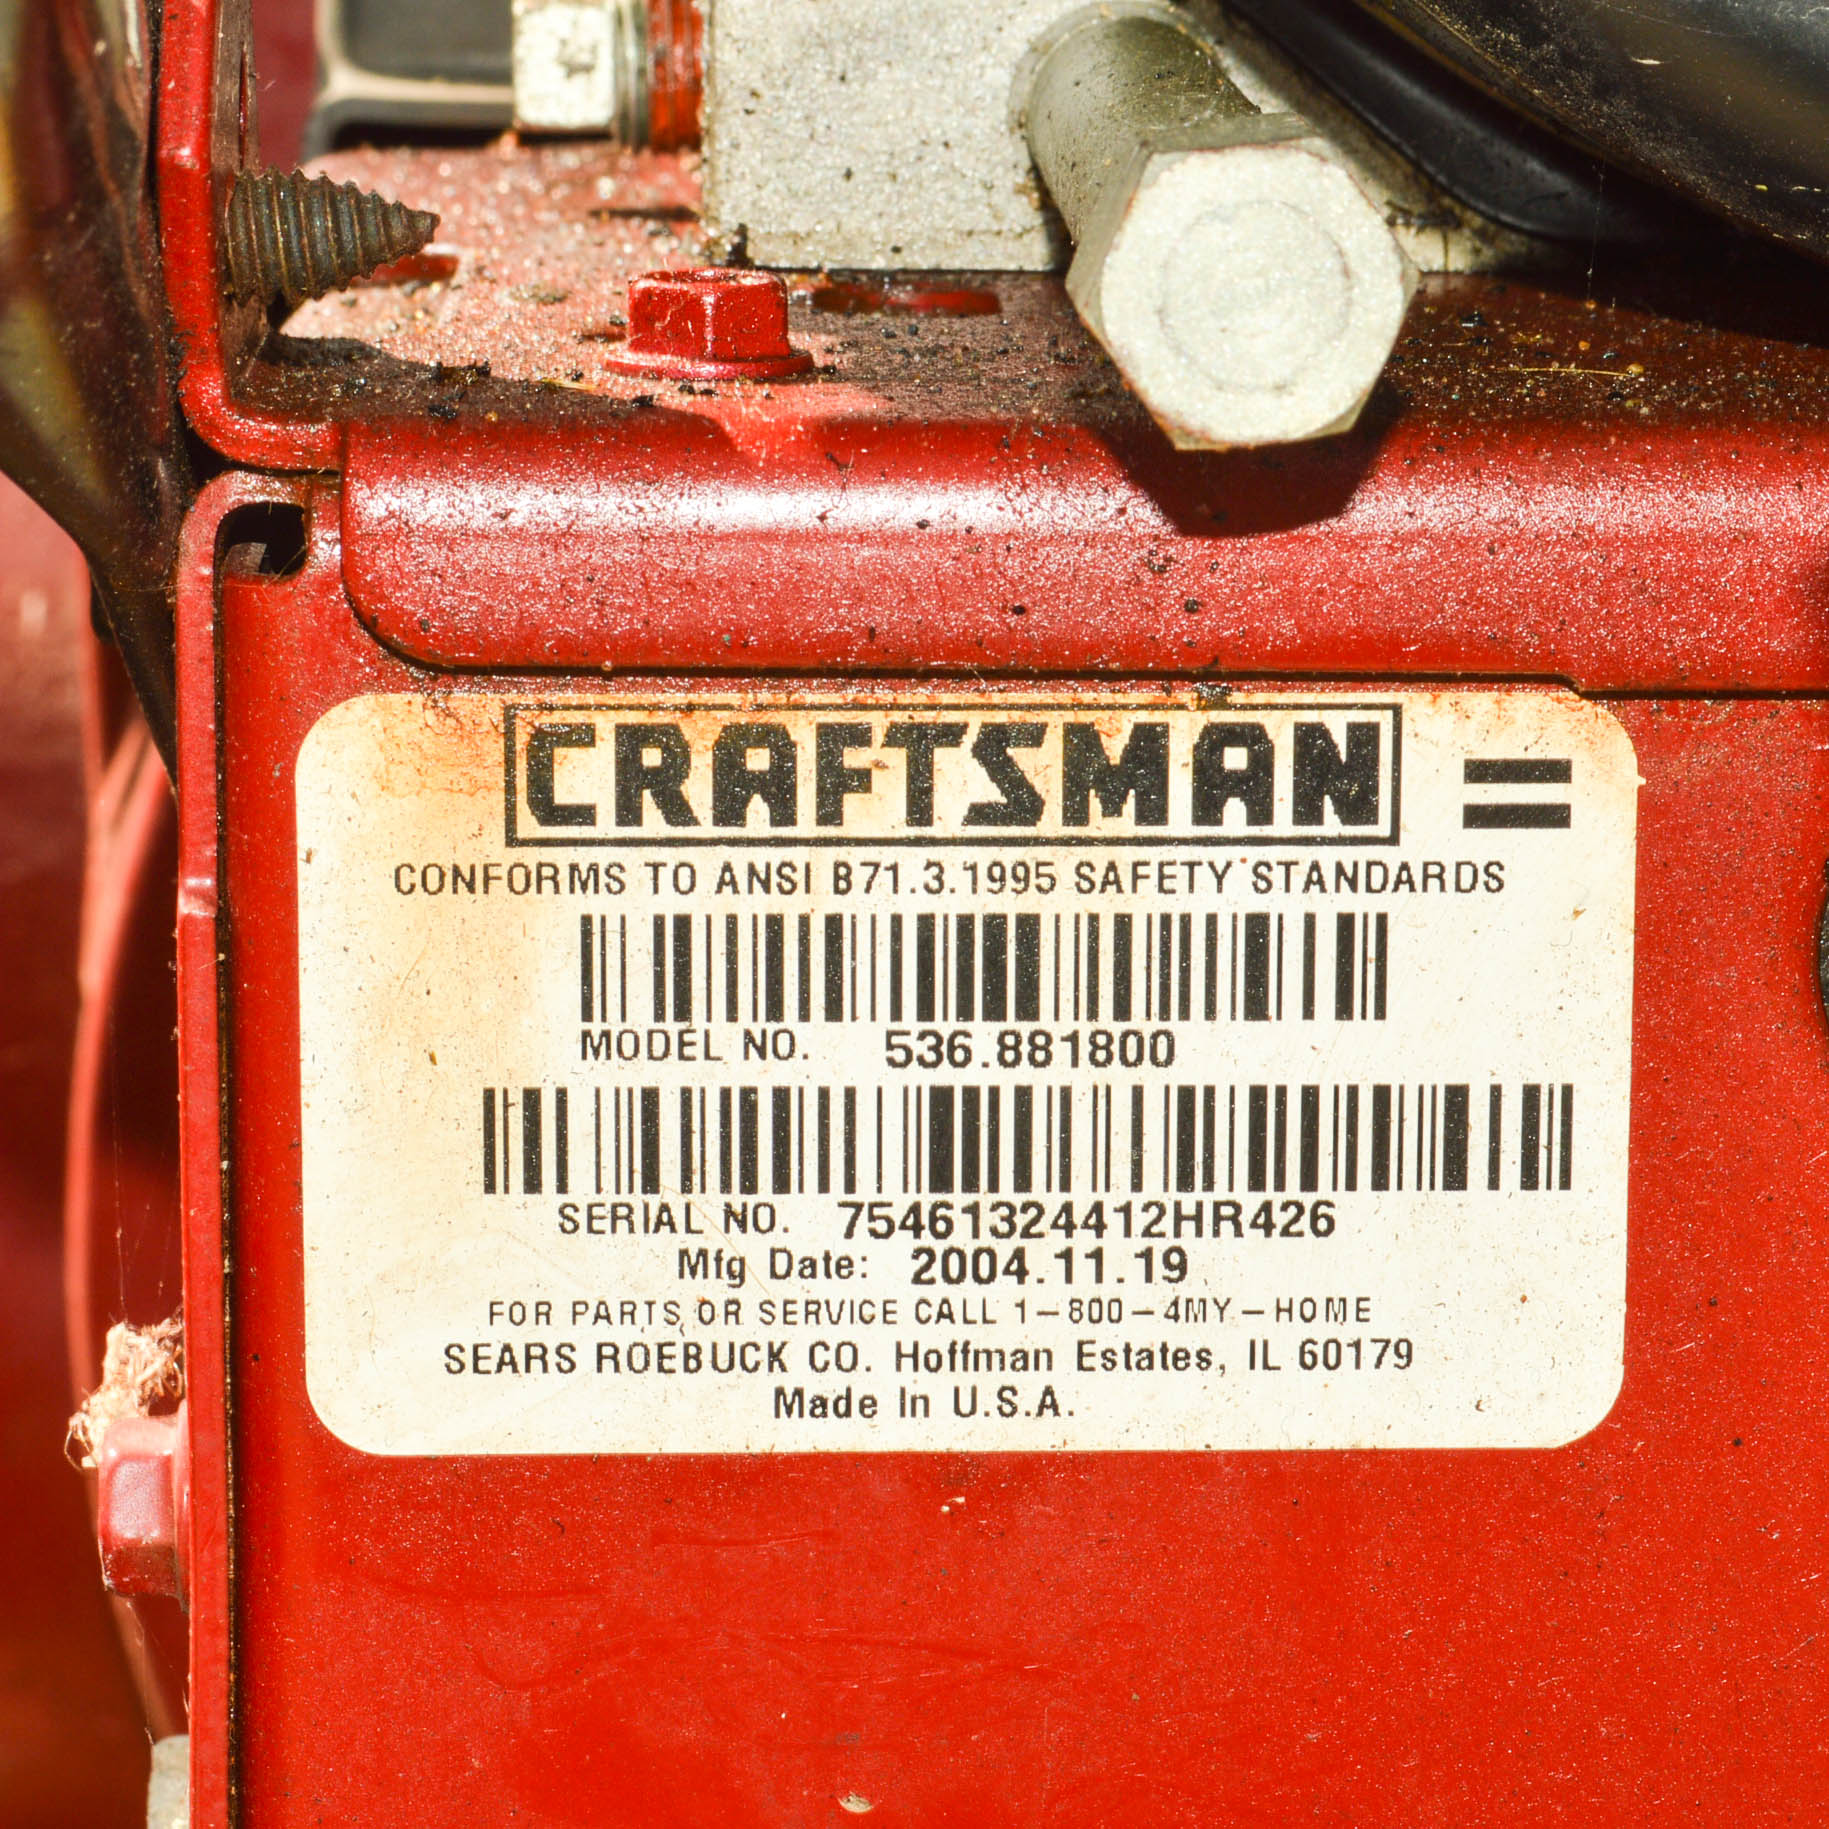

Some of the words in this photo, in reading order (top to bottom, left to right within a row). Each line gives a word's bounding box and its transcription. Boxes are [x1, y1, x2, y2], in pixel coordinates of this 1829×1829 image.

[525, 721, 1380, 828] CRAFTSMAN
[393, 861, 627, 896] CONFORMS
[643, 861, 697, 895] TO
[714, 861, 812, 895] ANSI
[832, 860, 1058, 895] B71.3.1995
[1074, 860, 1233, 895] SAFETY
[1251, 860, 1506, 894] STANDARDS
[581, 1028, 723, 1062] MODEL
[743, 1028, 810, 1061] NO.
[884, 1029, 1176, 1069] 536.881800
[558, 1201, 705, 1235] SERIAL
[722, 1201, 790, 1235] NO.
[836, 1200, 1337, 1240] 75461324412HR426
[677, 1247, 746, 1288] Mfg
[769, 1247, 868, 1280] Date:
[910, 1246, 1188, 1285] 2004.11.19
[488, 1300, 553, 1326] FOR
[572, 1300, 681, 1326] PARTS
[698, 1300, 743, 1325] OR
[759, 1299, 899, 1325] SERVICE
[914, 1298, 997, 1325] CALL
[443, 1342, 577, 1374] SEARS
[596, 1341, 789, 1374] ROEBUCK
[808, 1341, 873, 1373] CO.
[895, 1340, 1053, 1373] Hoffman
[1077, 1339, 1227, 1376] Estates,
[1248, 1338, 1282, 1371] IL
[1298, 1338, 1413, 1371] 60179
[774, 1386, 879, 1419] Made
[899, 1387, 930, 1418] In
[953, 1385, 1075, 1418] U.S.A.
